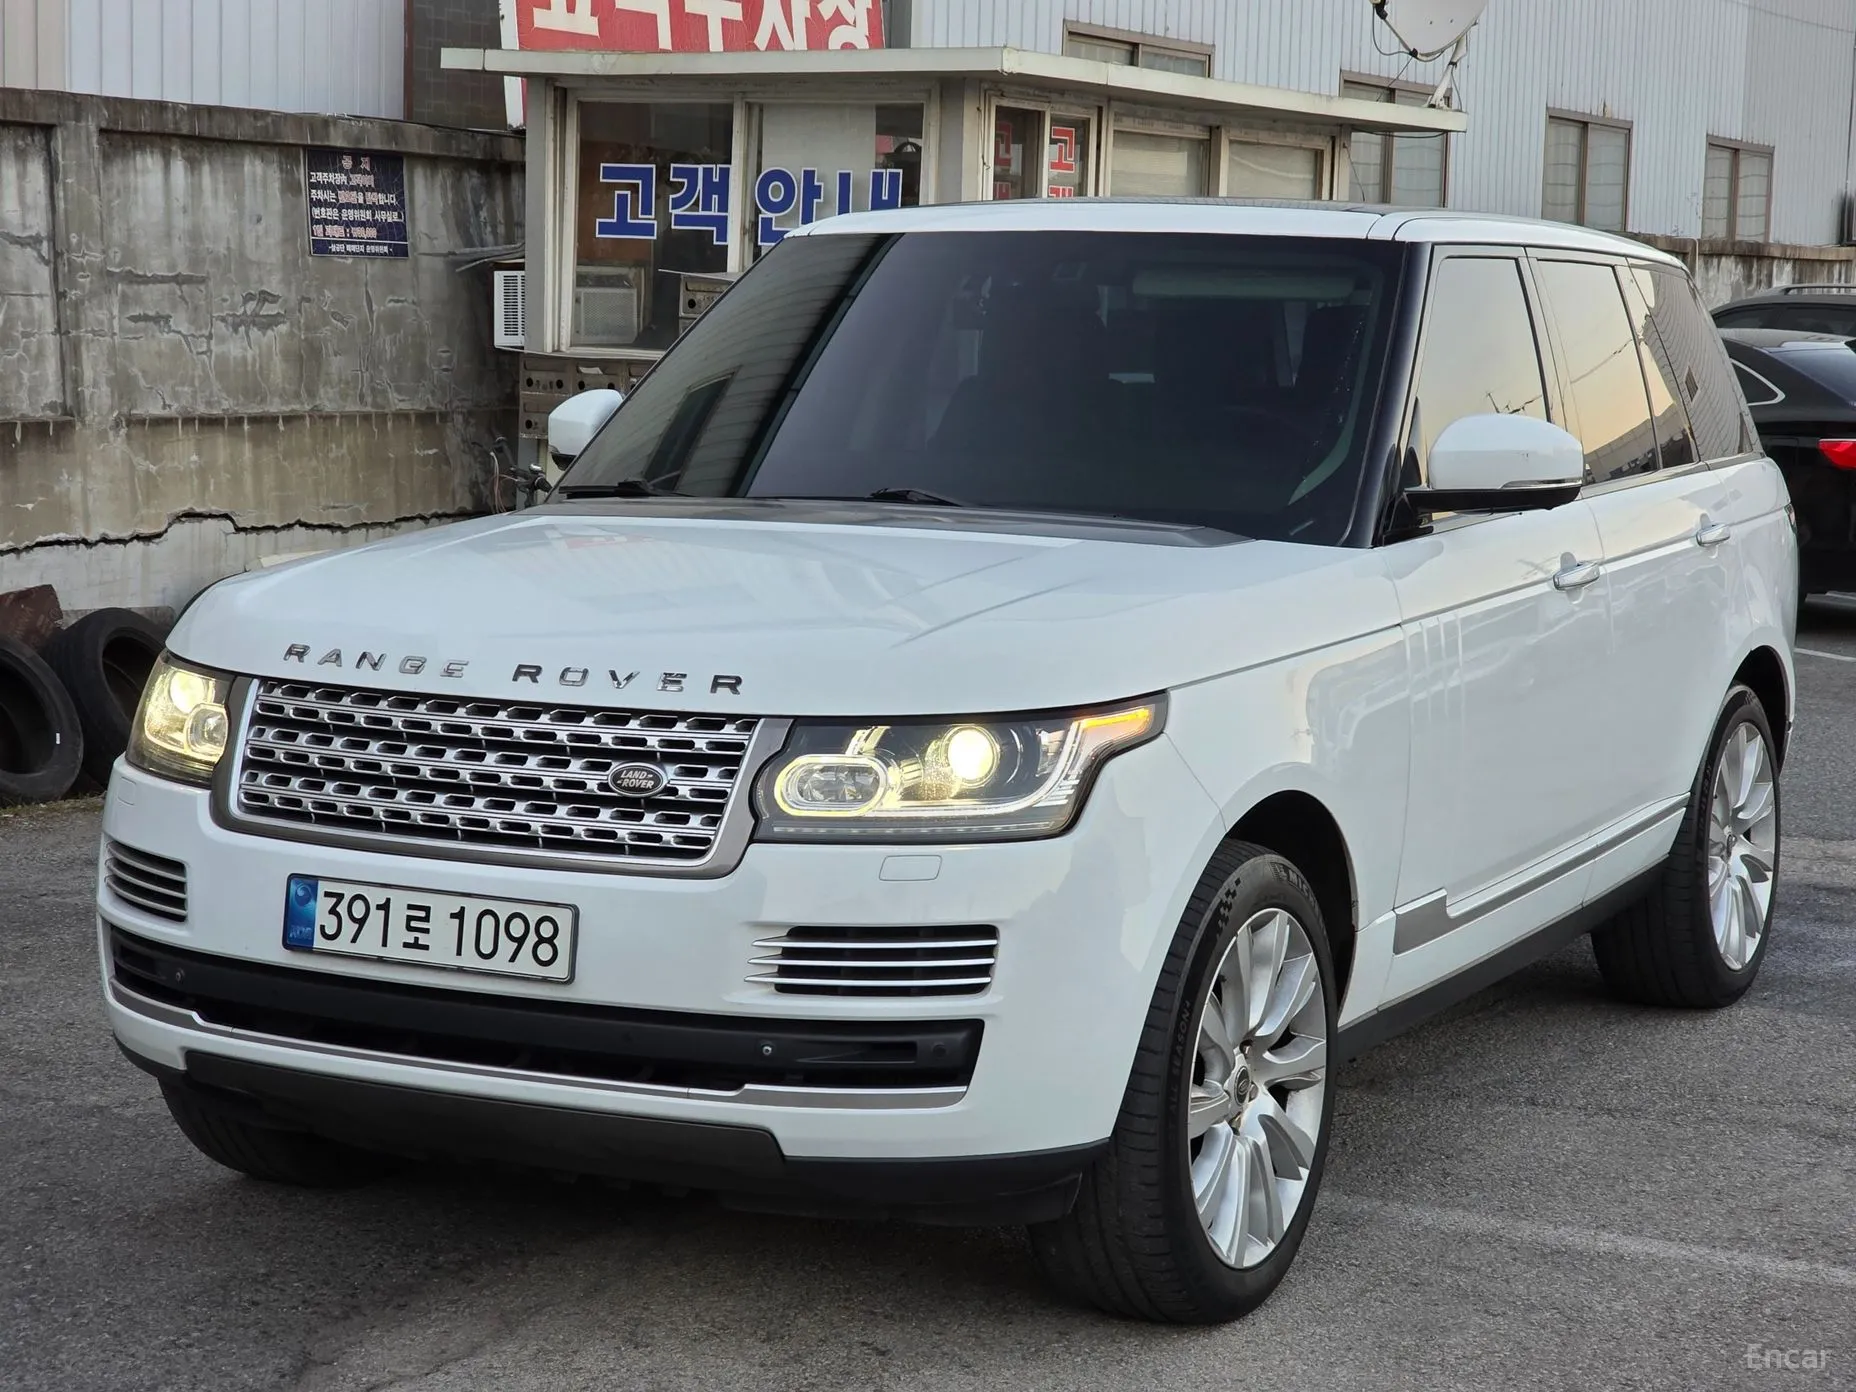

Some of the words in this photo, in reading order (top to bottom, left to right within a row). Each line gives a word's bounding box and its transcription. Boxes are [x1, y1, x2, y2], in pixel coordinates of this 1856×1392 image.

[283, 643, 470, 679] RANGE
[512, 663, 743, 696] ROVER
[620, 770, 648, 779] LAND
[621, 779, 655, 789] ROVER
[319, 890, 431, 951] 391로
[450, 905, 560, 968] 1098
